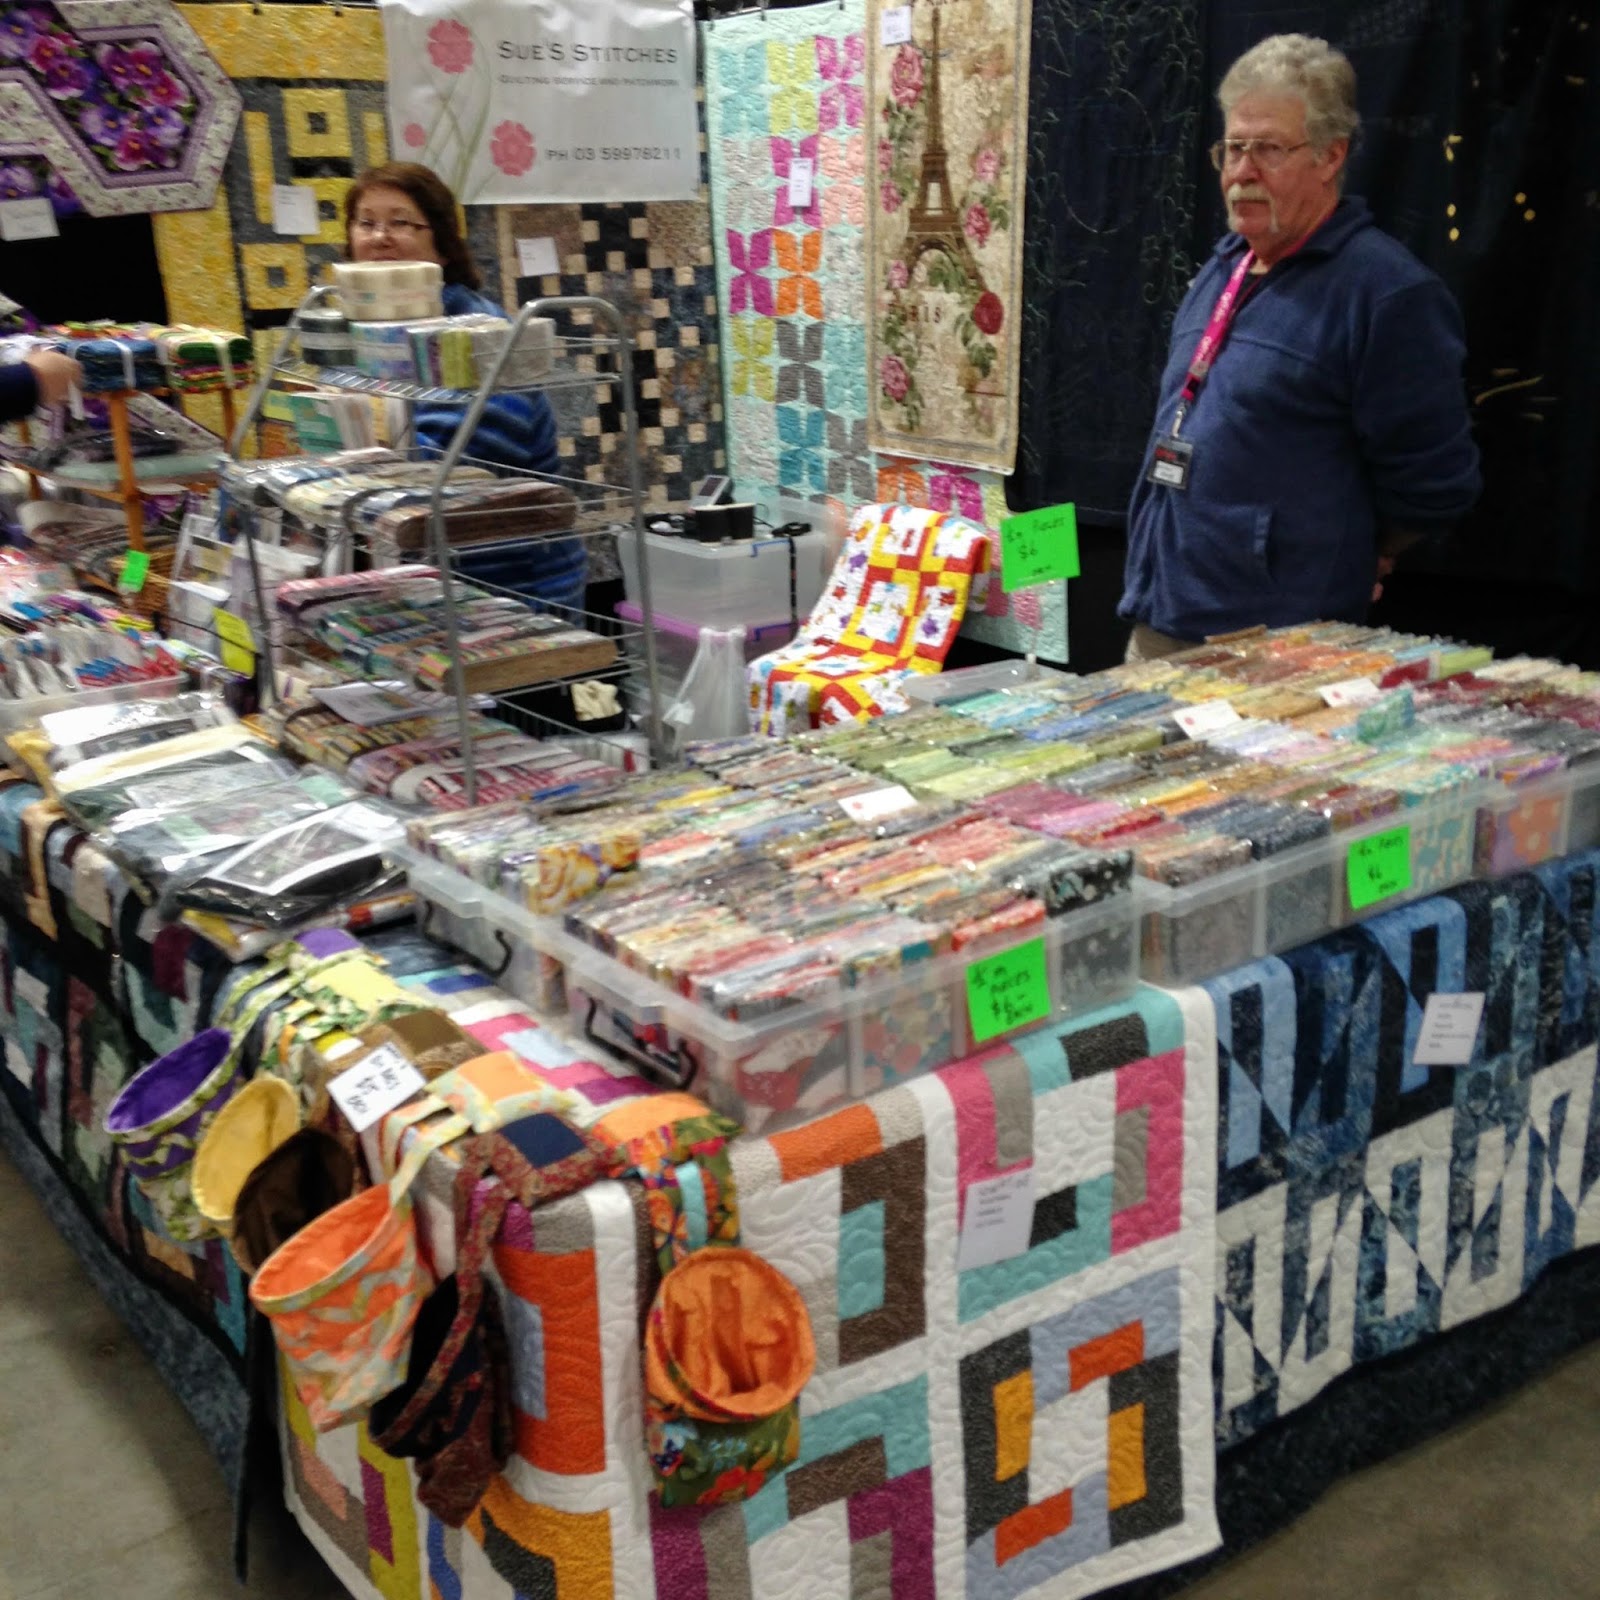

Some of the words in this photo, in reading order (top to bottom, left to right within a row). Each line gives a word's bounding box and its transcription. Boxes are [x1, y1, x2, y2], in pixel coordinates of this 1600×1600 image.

[499, 40, 565, 61] SUE'S
[572, 44, 678, 63] STITCHES
[545, 149, 568, 160] PH
[575, 147, 596, 160] 03
